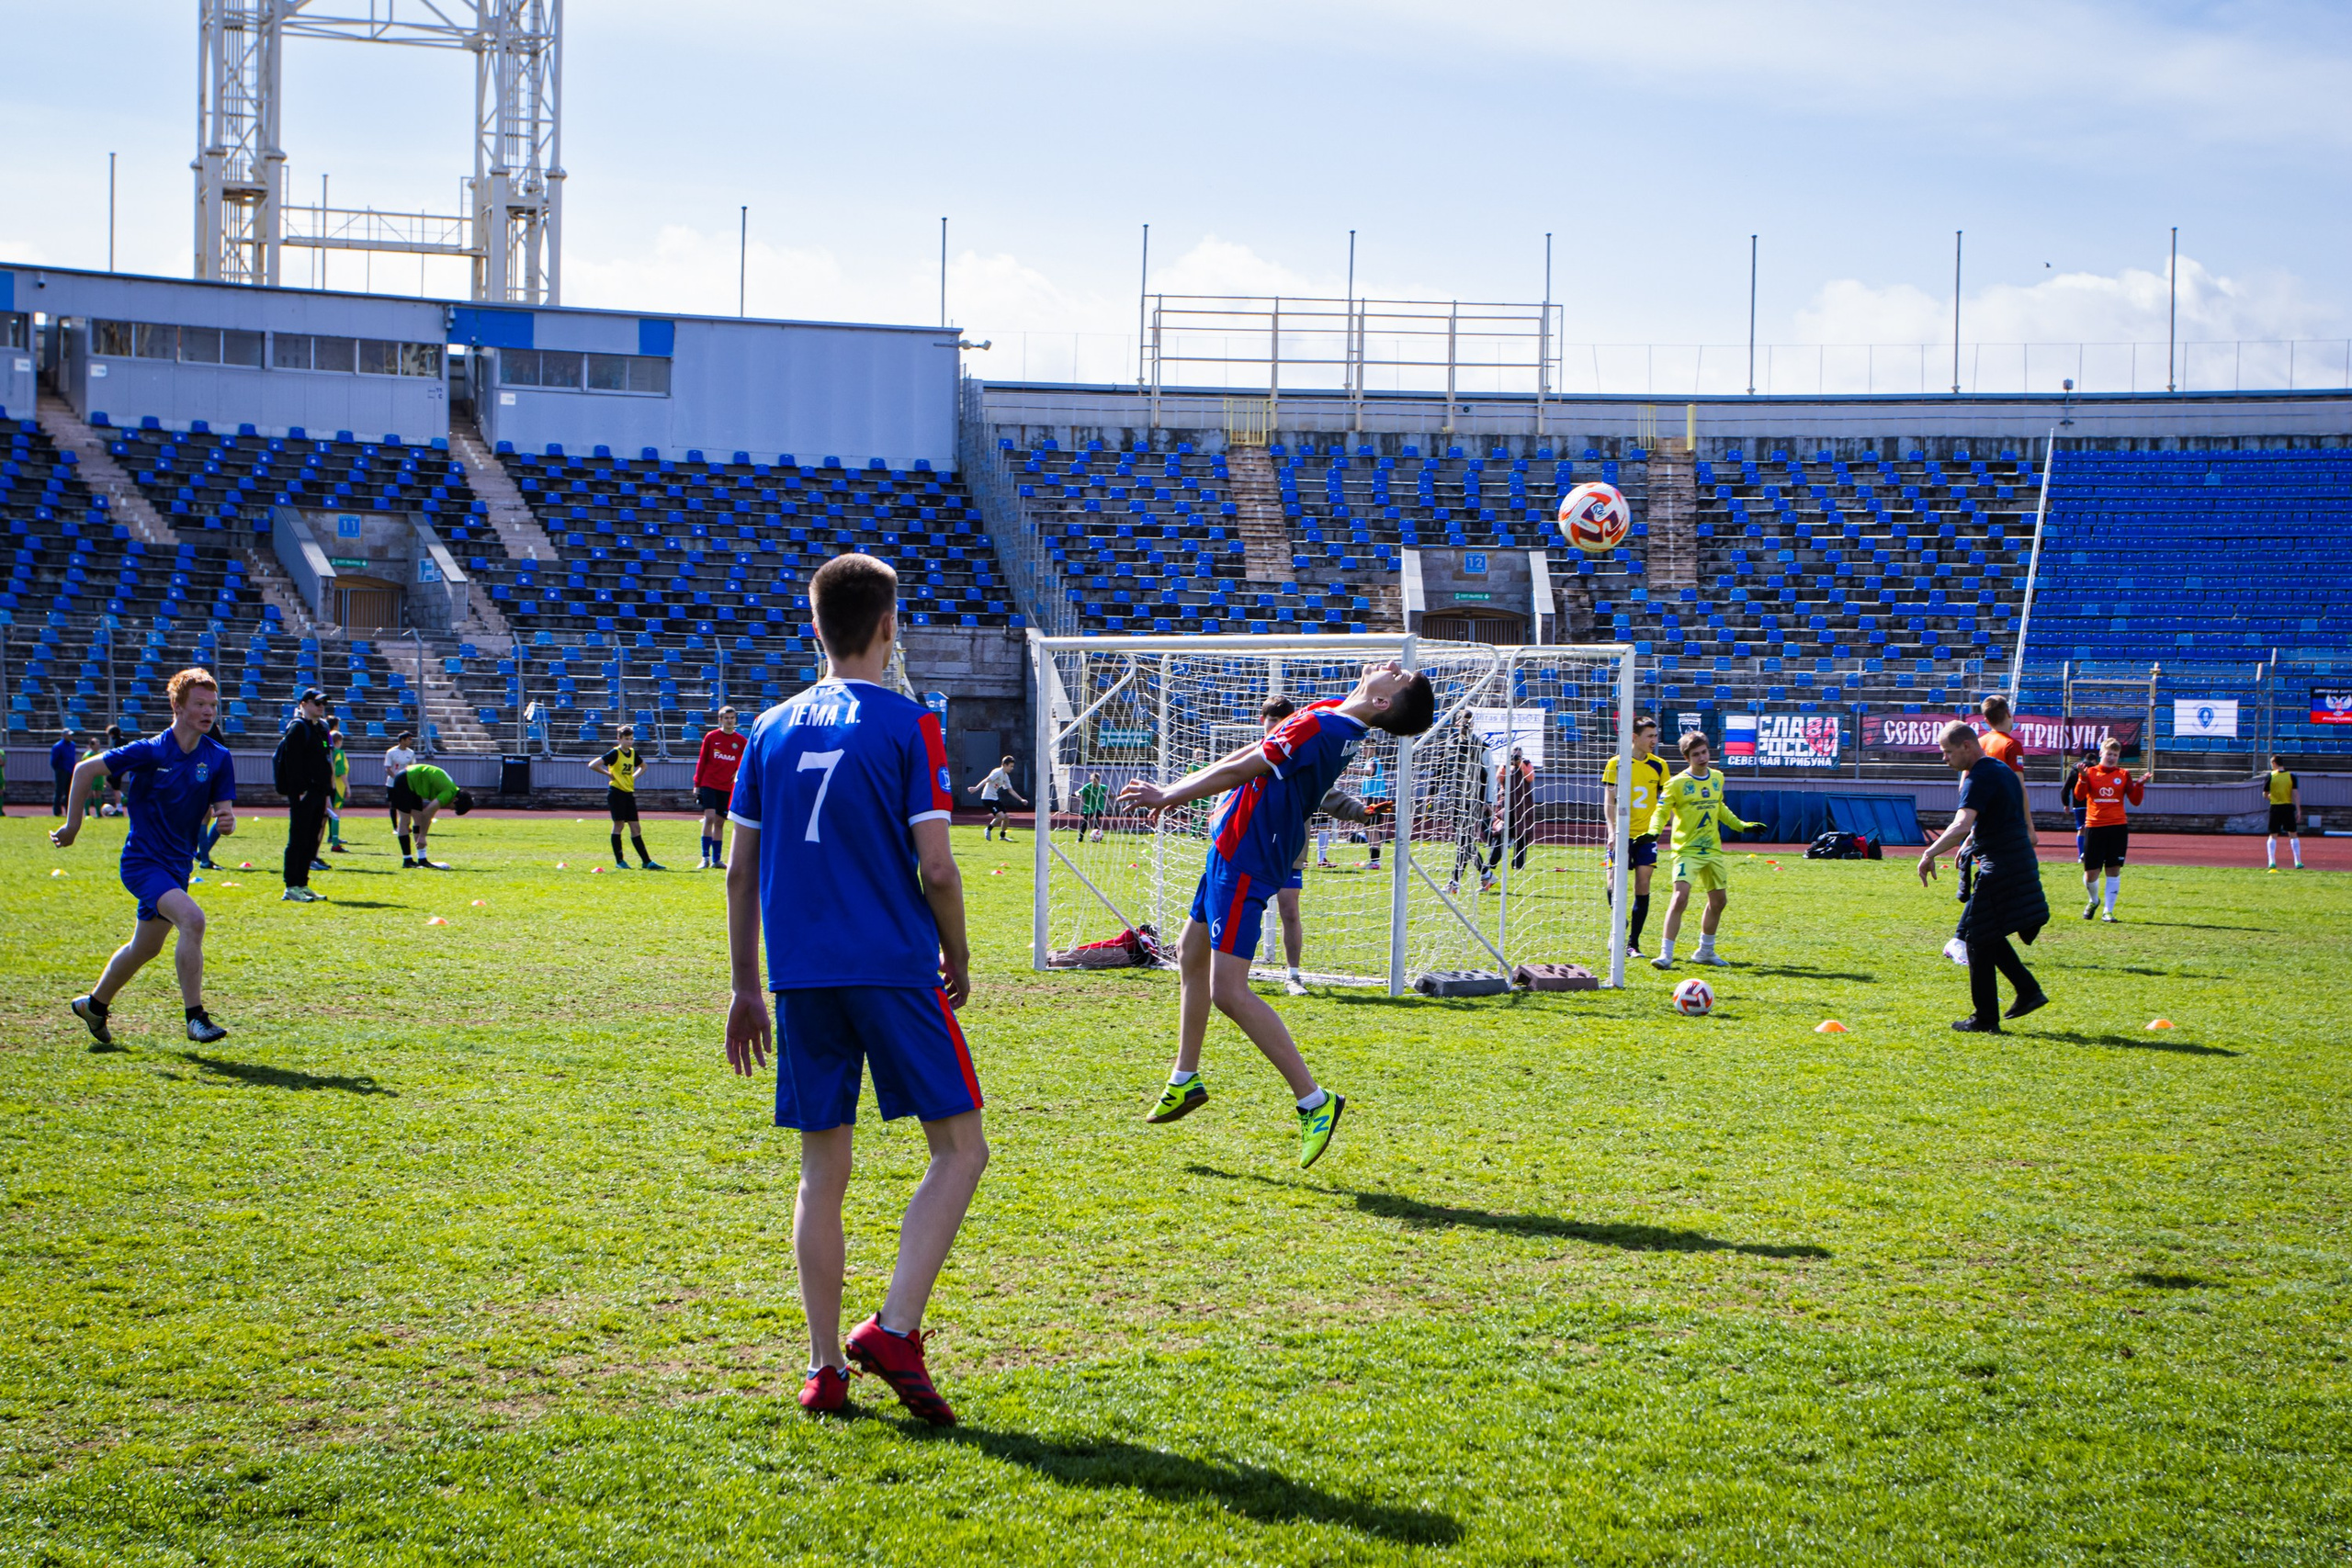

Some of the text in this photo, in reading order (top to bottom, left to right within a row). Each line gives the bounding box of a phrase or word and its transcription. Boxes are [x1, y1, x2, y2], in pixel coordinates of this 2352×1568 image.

[1468, 557, 1484, 568] 12
[1758, 716, 1838, 738] СЛАВА
[714, 751, 736, 761] FAMA
[1784, 756, 1833, 766] ТРИБУНА
[797, 749, 845, 843] 7
[1633, 786, 1648, 808] 2
[1678, 863, 1687, 876] 1
[1211, 917, 1221, 938] 6
